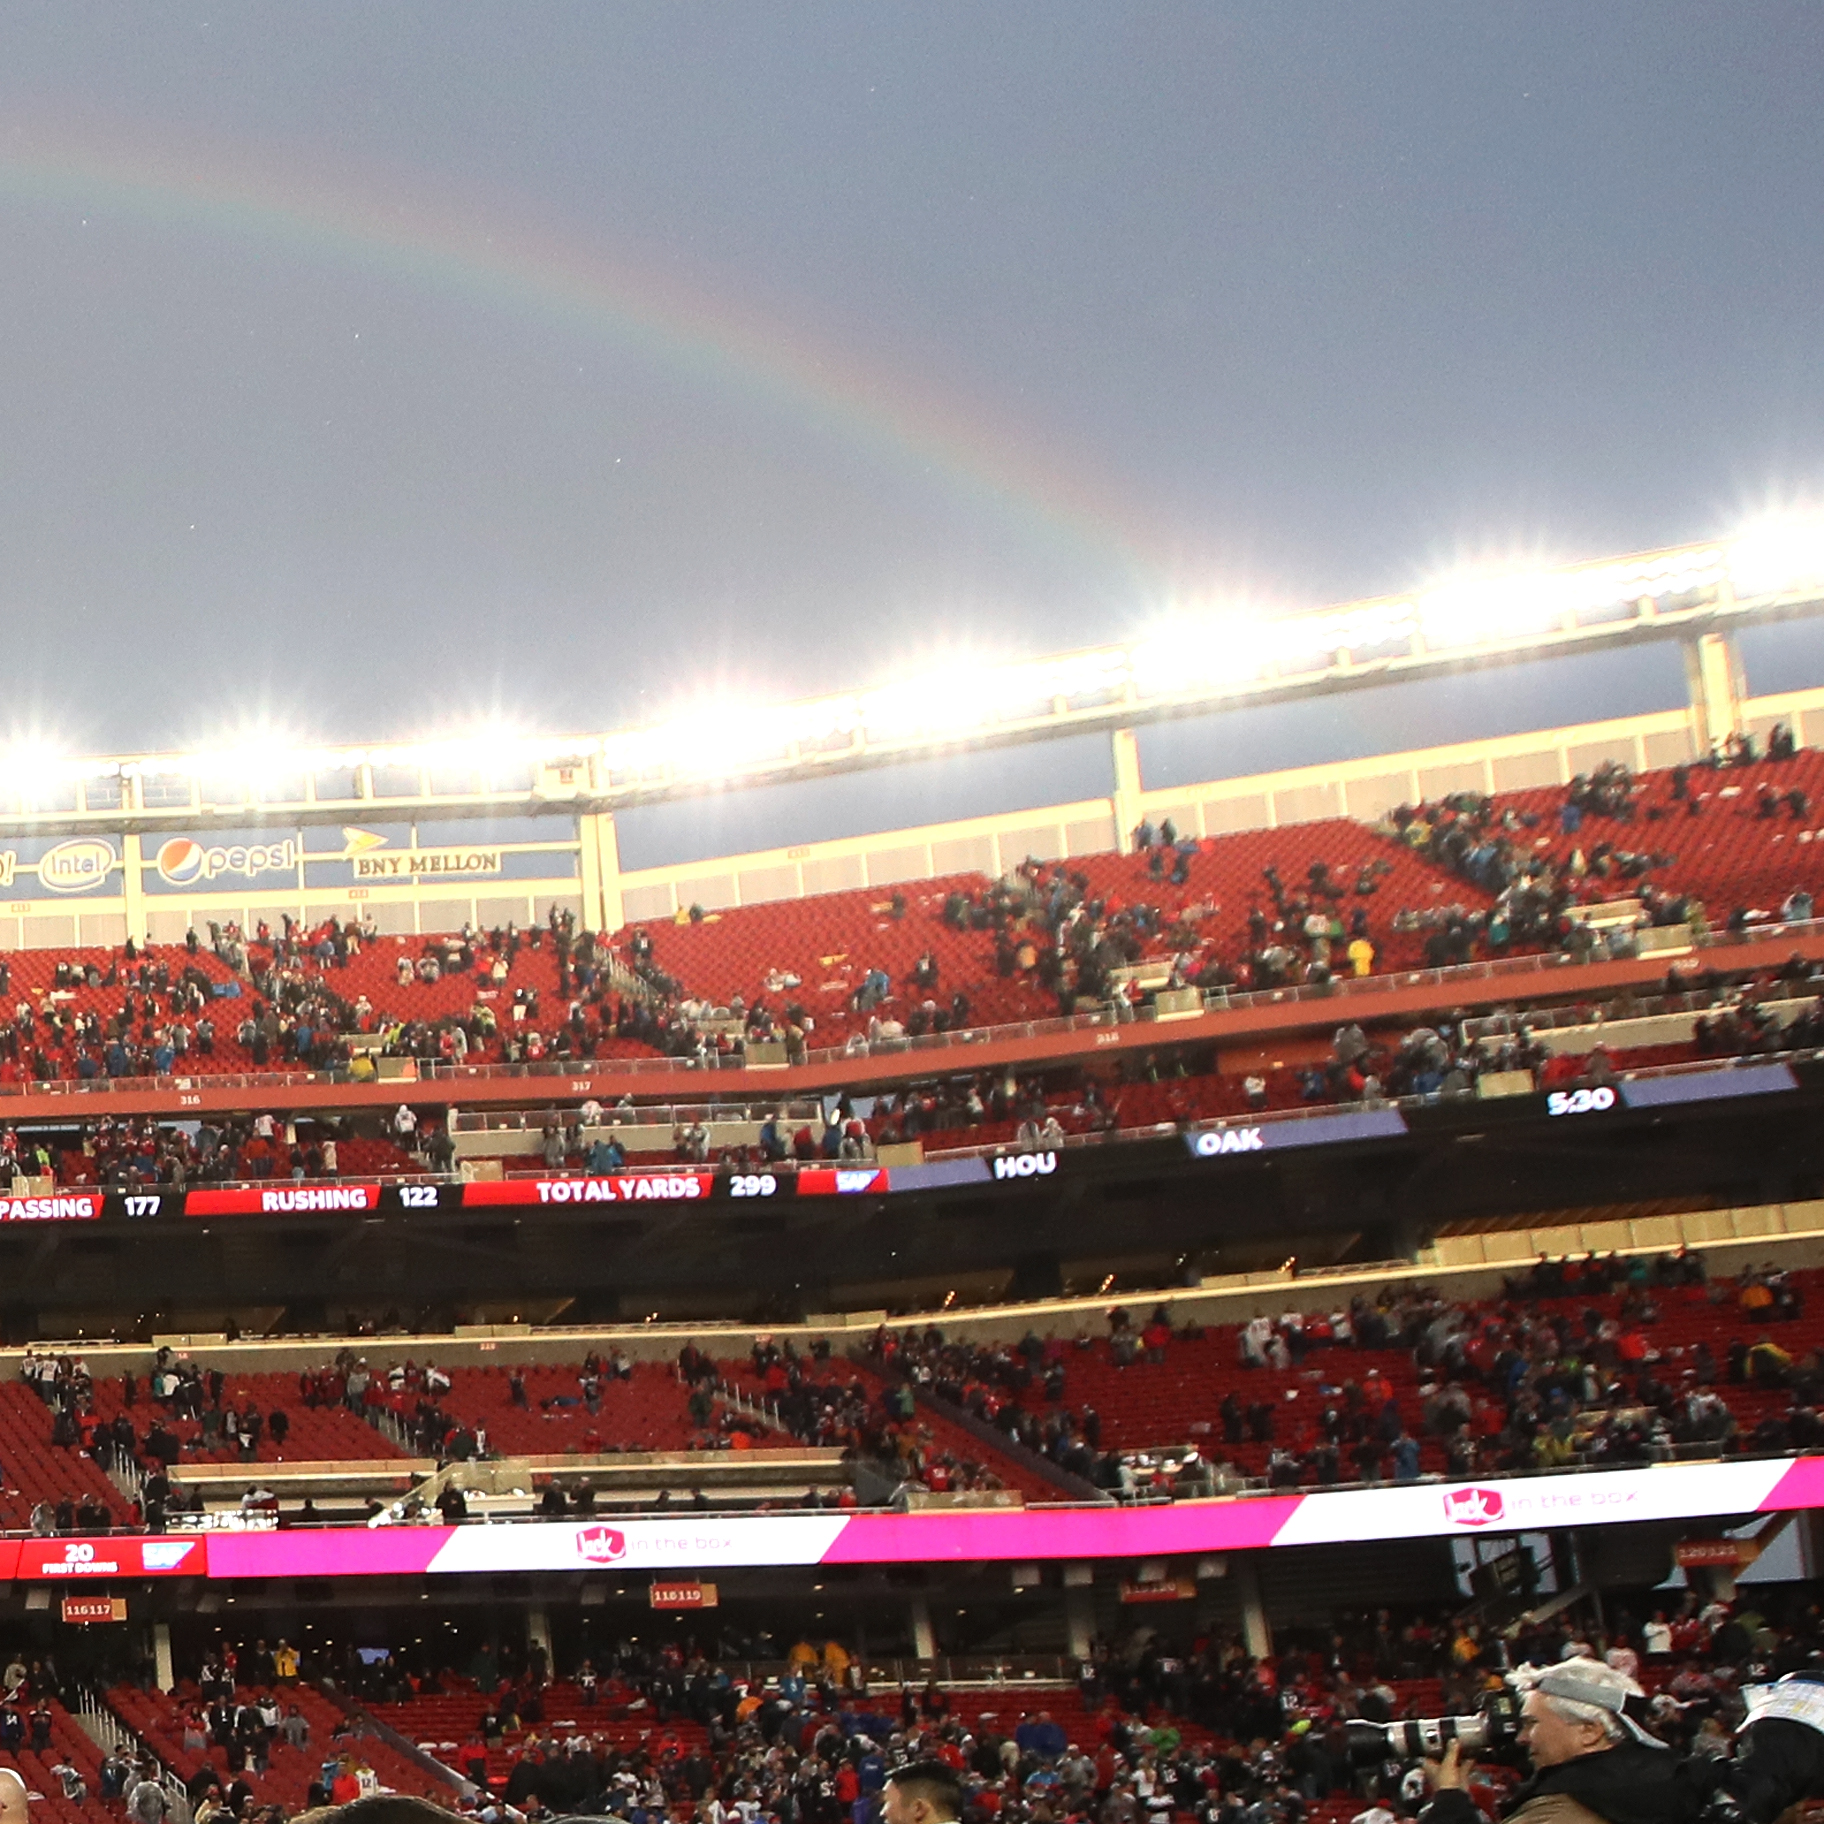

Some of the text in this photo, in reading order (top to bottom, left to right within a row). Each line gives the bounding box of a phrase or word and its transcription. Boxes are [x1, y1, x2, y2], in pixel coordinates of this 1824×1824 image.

[358, 852, 497, 876] BNY MELLON
[180, 1095, 201, 1105] 316
[1547, 1086, 1615, 1118] 5:30
[1195, 1126, 1265, 1156] OAK
[994, 1151, 1057, 1180] HOU
[537, 1175, 777, 1202] TOTAL YARDS 299
[836, 1173, 873, 1191] SAP
[124, 1195, 161, 1217] 177
[262, 1186, 439, 1211] RUSHING 122
[1511, 1498, 1532, 1510] in
[1542, 1494, 1582, 1507] the
[1591, 1490, 1639, 1505] box
[65, 1544, 95, 1562] 20
[631, 1540, 648, 1550] in
[656, 1537, 688, 1549] the
[696, 1536, 732, 1549] box
[42, 1561, 118, 1574] FIRST DOWNS
[65, 1604, 112, 1617] 116 117
